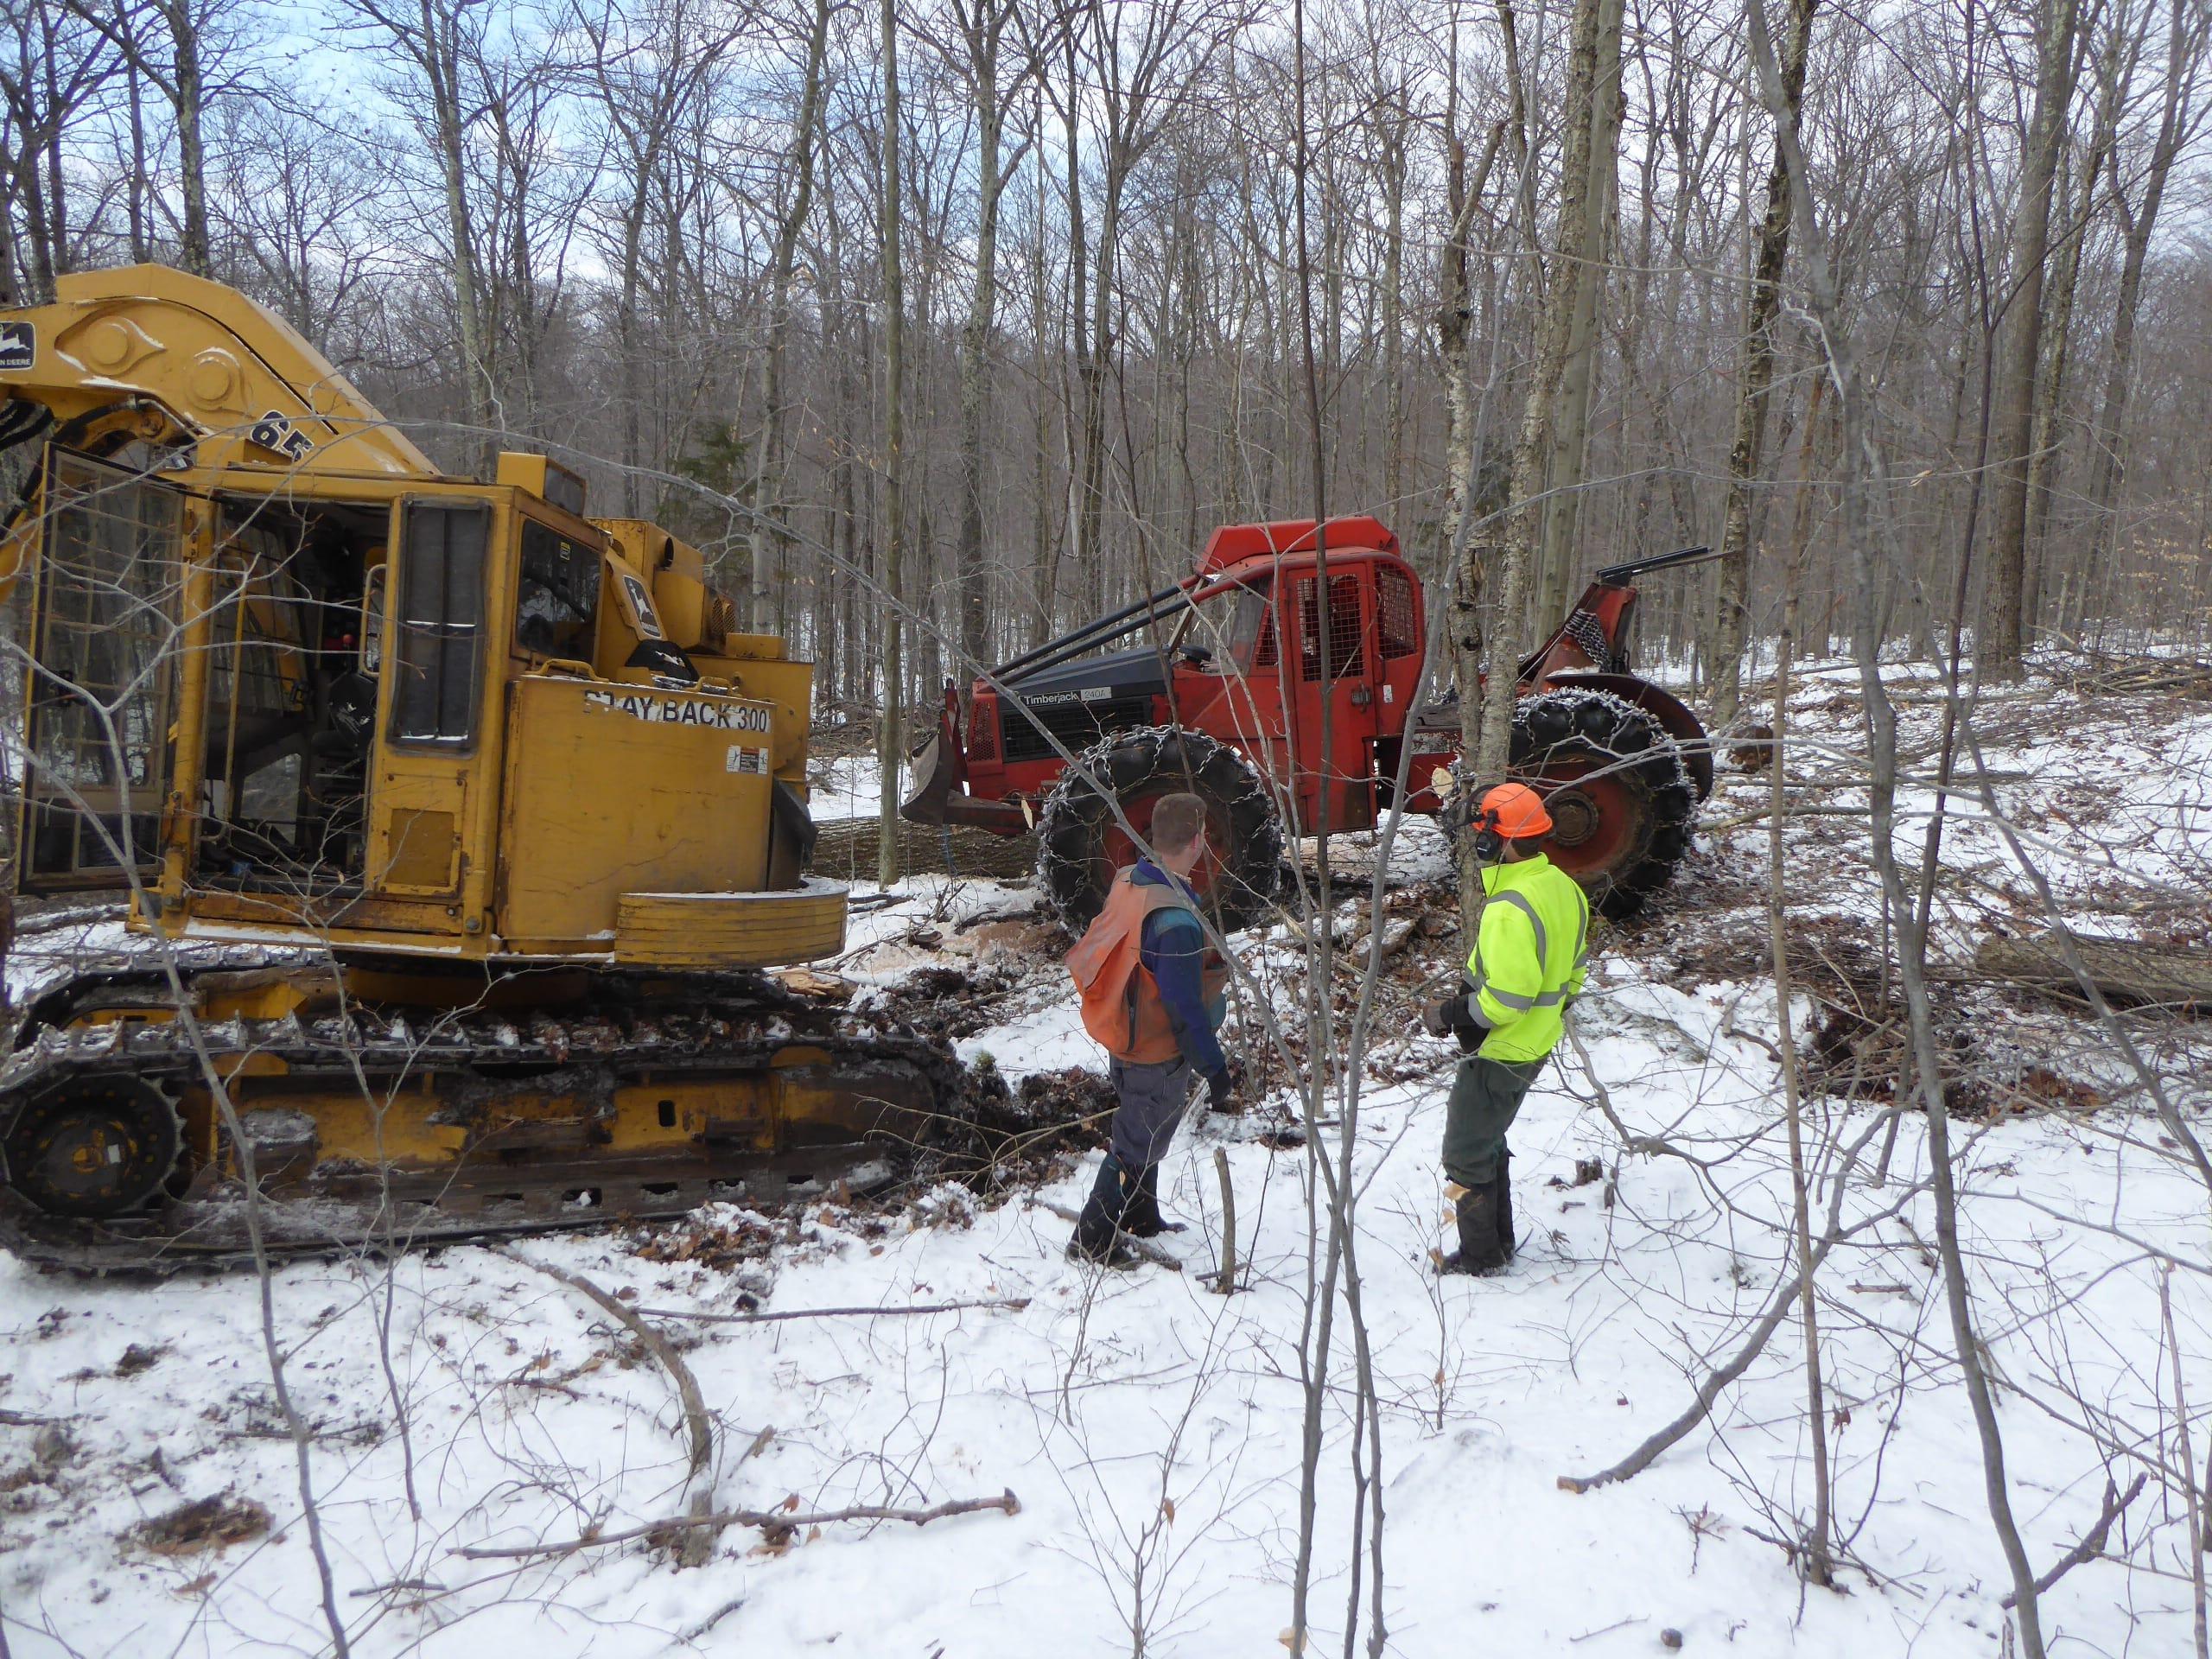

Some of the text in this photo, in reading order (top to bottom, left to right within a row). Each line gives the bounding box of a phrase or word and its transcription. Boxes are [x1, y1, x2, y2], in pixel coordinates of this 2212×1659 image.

[1024, 691, 1078, 705] Timberjack
[663, 699, 731, 728] BACK
[738, 707, 766, 733] 300
